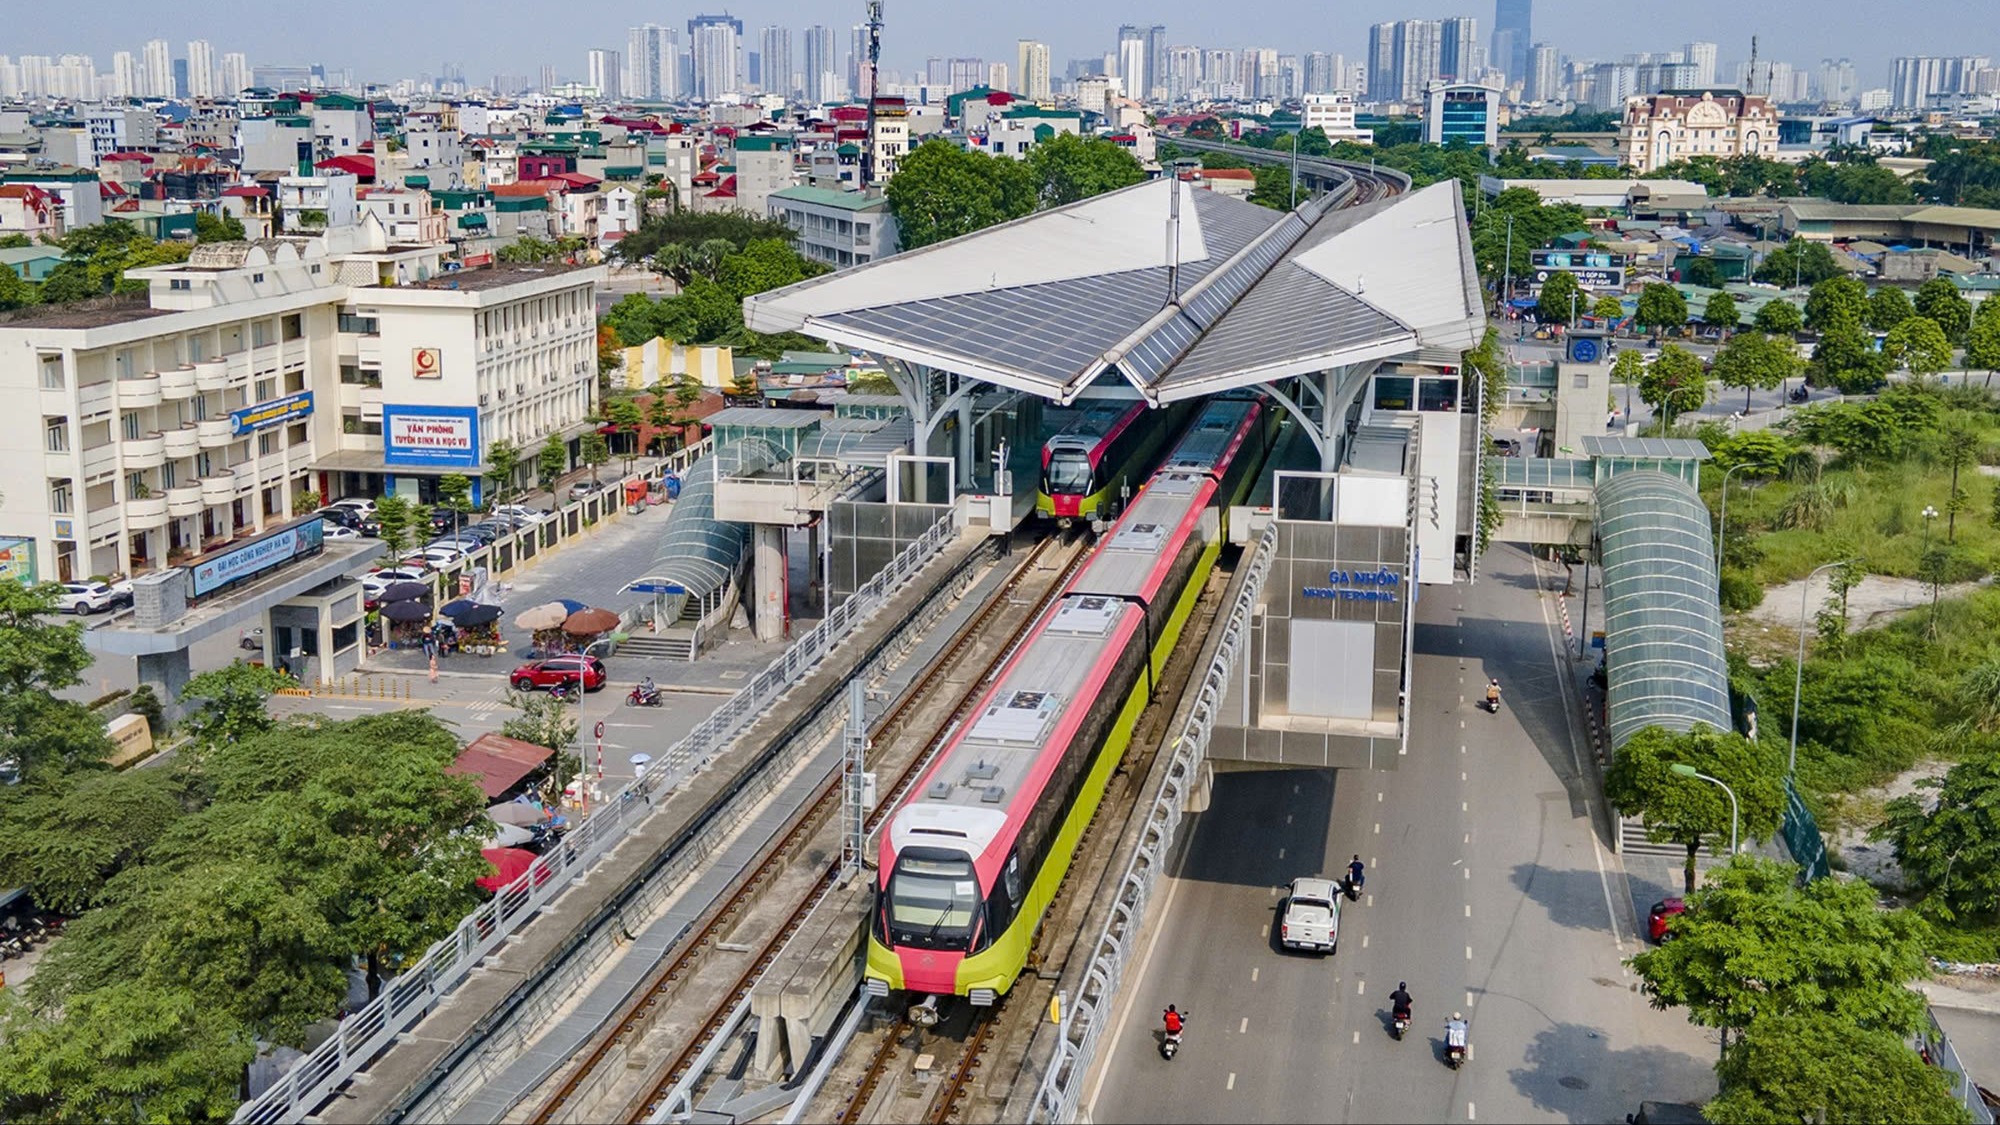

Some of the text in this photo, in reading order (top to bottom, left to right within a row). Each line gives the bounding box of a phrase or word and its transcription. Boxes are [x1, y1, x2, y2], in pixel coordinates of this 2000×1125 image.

[407, 424, 454, 434] VĂN PHÒNG
[1329, 566, 1399, 586] GA NHỔN
[1303, 587, 1398, 602] NHON TERMINAL
